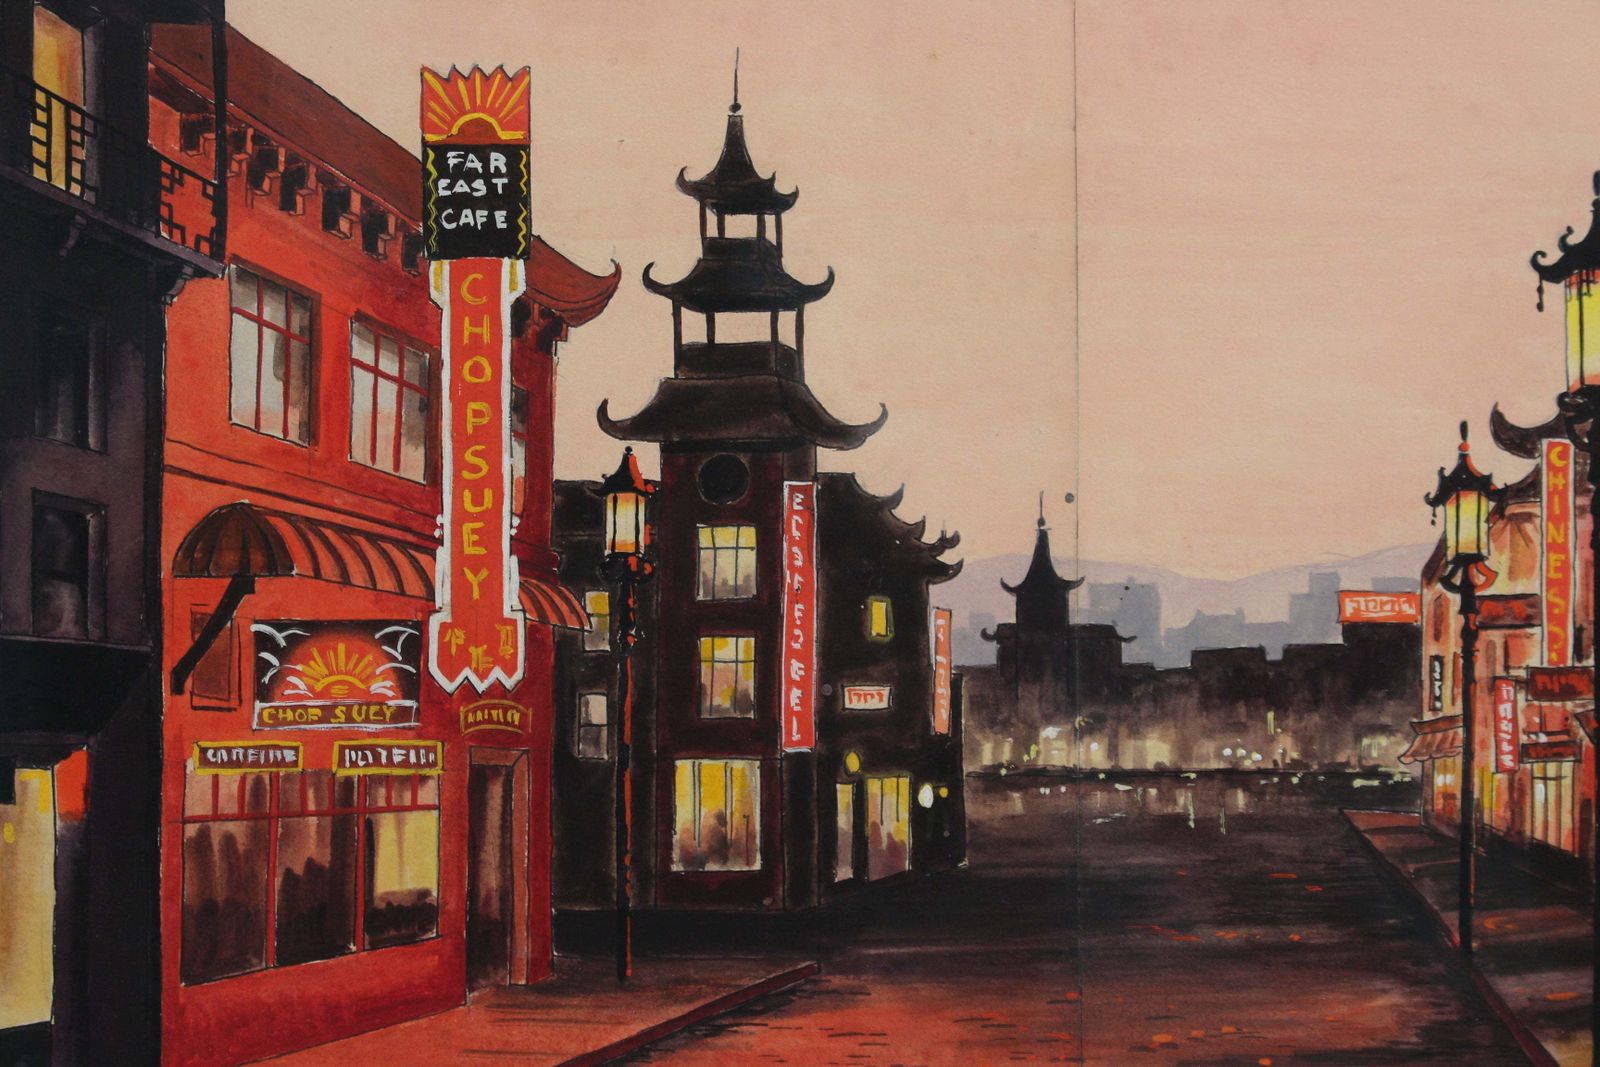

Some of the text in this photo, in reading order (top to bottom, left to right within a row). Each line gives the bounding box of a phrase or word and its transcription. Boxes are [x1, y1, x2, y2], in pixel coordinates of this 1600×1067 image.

[446, 151, 508, 174] FAR
[437, 178, 509, 197] EAST
[439, 208, 508, 231] CAFE
[261, 704, 397, 725] CHOP SUEY
